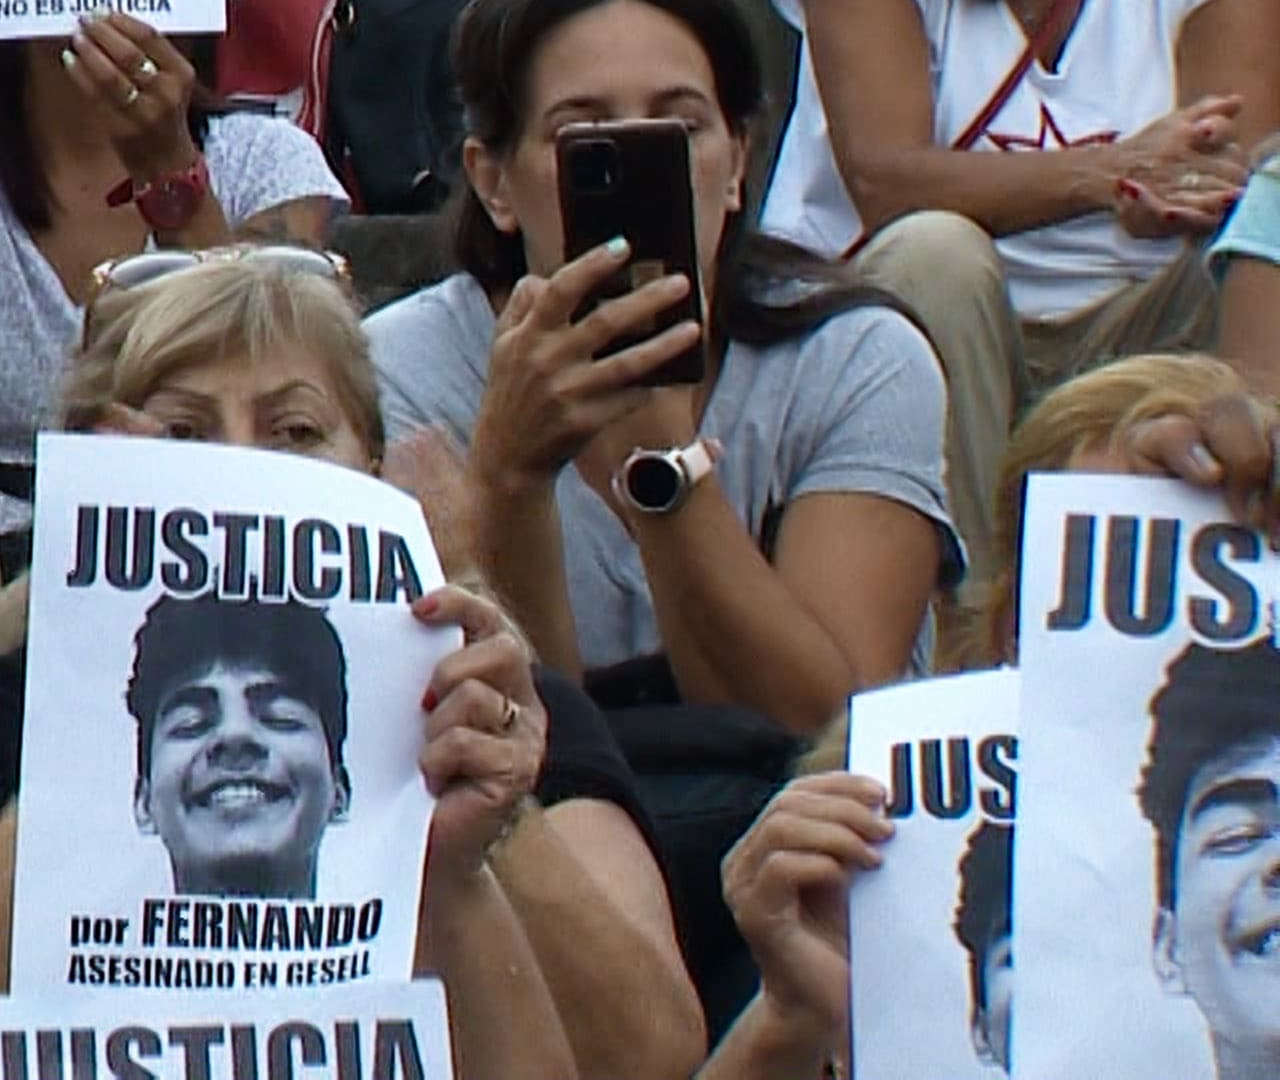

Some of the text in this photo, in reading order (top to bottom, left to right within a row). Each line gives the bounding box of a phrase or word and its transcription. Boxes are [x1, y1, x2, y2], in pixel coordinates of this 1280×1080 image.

[66, 503, 423, 604] JUSTICIA
[1046, 512, 1261, 642] JUS
[70, 898, 383, 951] por FERNANDO
[68, 952, 372, 988] ASESINADO EN GESELL
[1, 1017, 427, 1080] JUSTICIA
